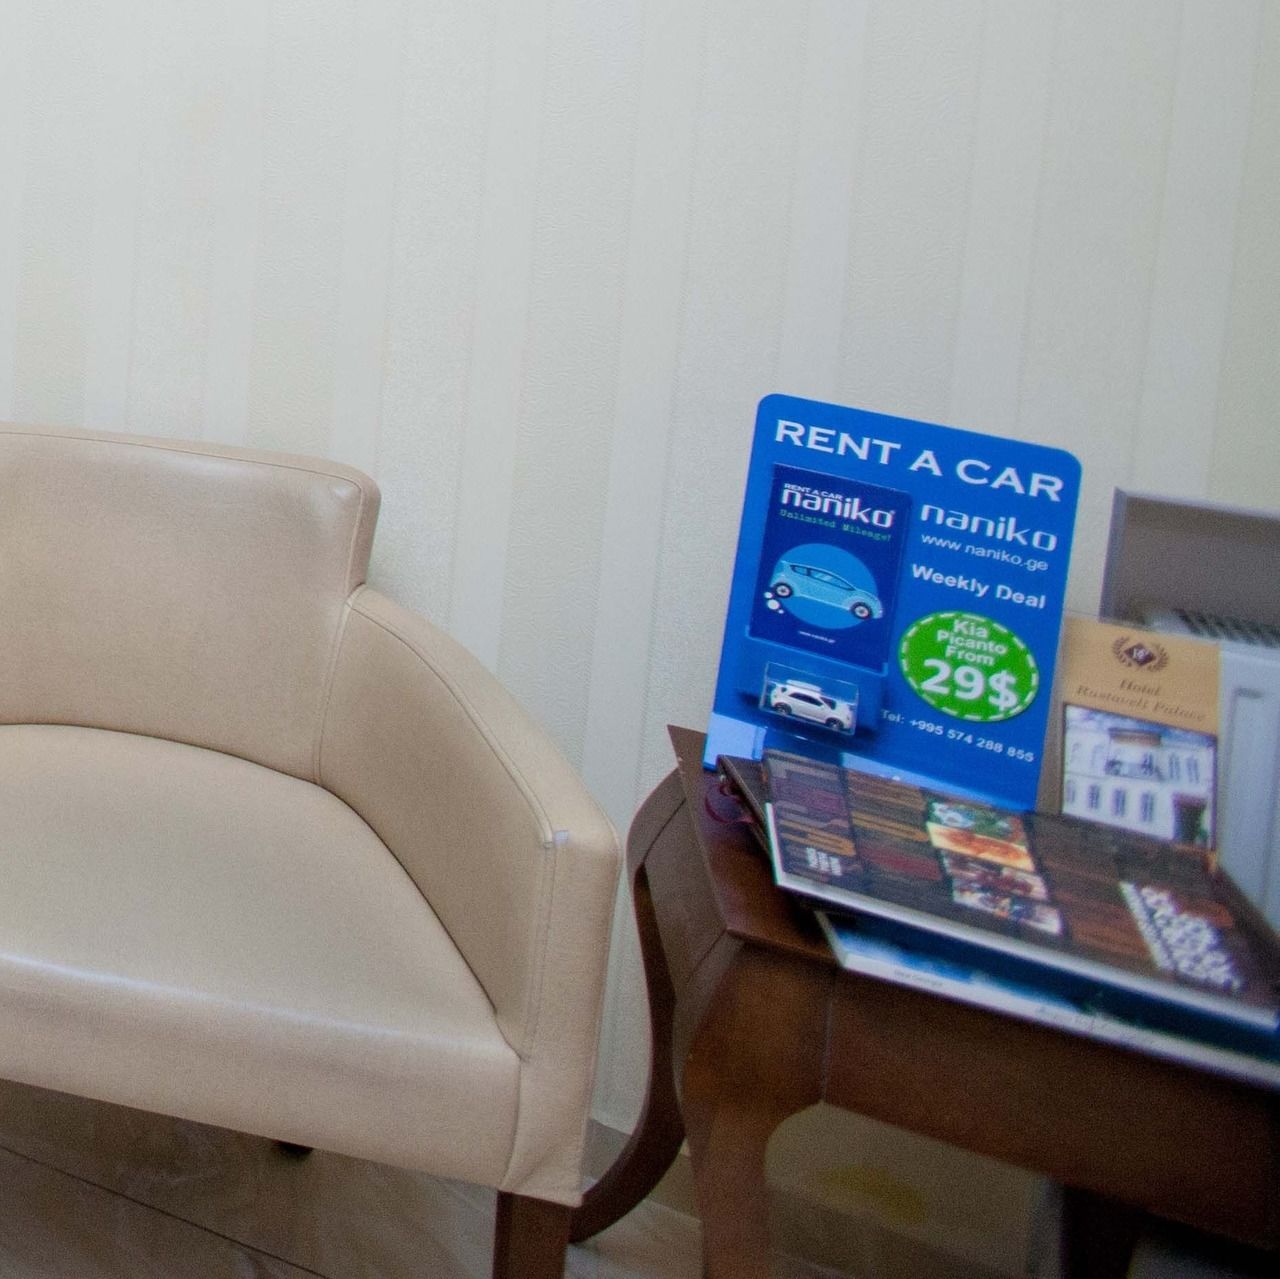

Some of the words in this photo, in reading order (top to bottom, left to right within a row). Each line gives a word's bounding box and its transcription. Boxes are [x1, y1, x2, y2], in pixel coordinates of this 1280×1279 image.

[775, 419, 902, 465] RENT
[909, 450, 943, 477] A
[956, 459, 1064, 502] CAR
[782, 489, 893, 528] naniko
[784, 483, 811, 493] RENT
[821, 491, 842, 500] CAR
[780, 509, 836, 528] Unlimited
[920, 504, 1057, 552] naniko
[912, 564, 990, 597] Weekly
[996, 584, 1046, 609] Deal
[937, 630, 1008, 655] Picanto
[953, 619, 988, 638] Kia
[945, 645, 995, 666] From
[920, 658, 1018, 711] 29$
[881, 710, 905, 724] Tel:
[909, 720, 944, 736] +995
[947, 729, 973, 744] 574
[976, 737, 1003, 753] 288
